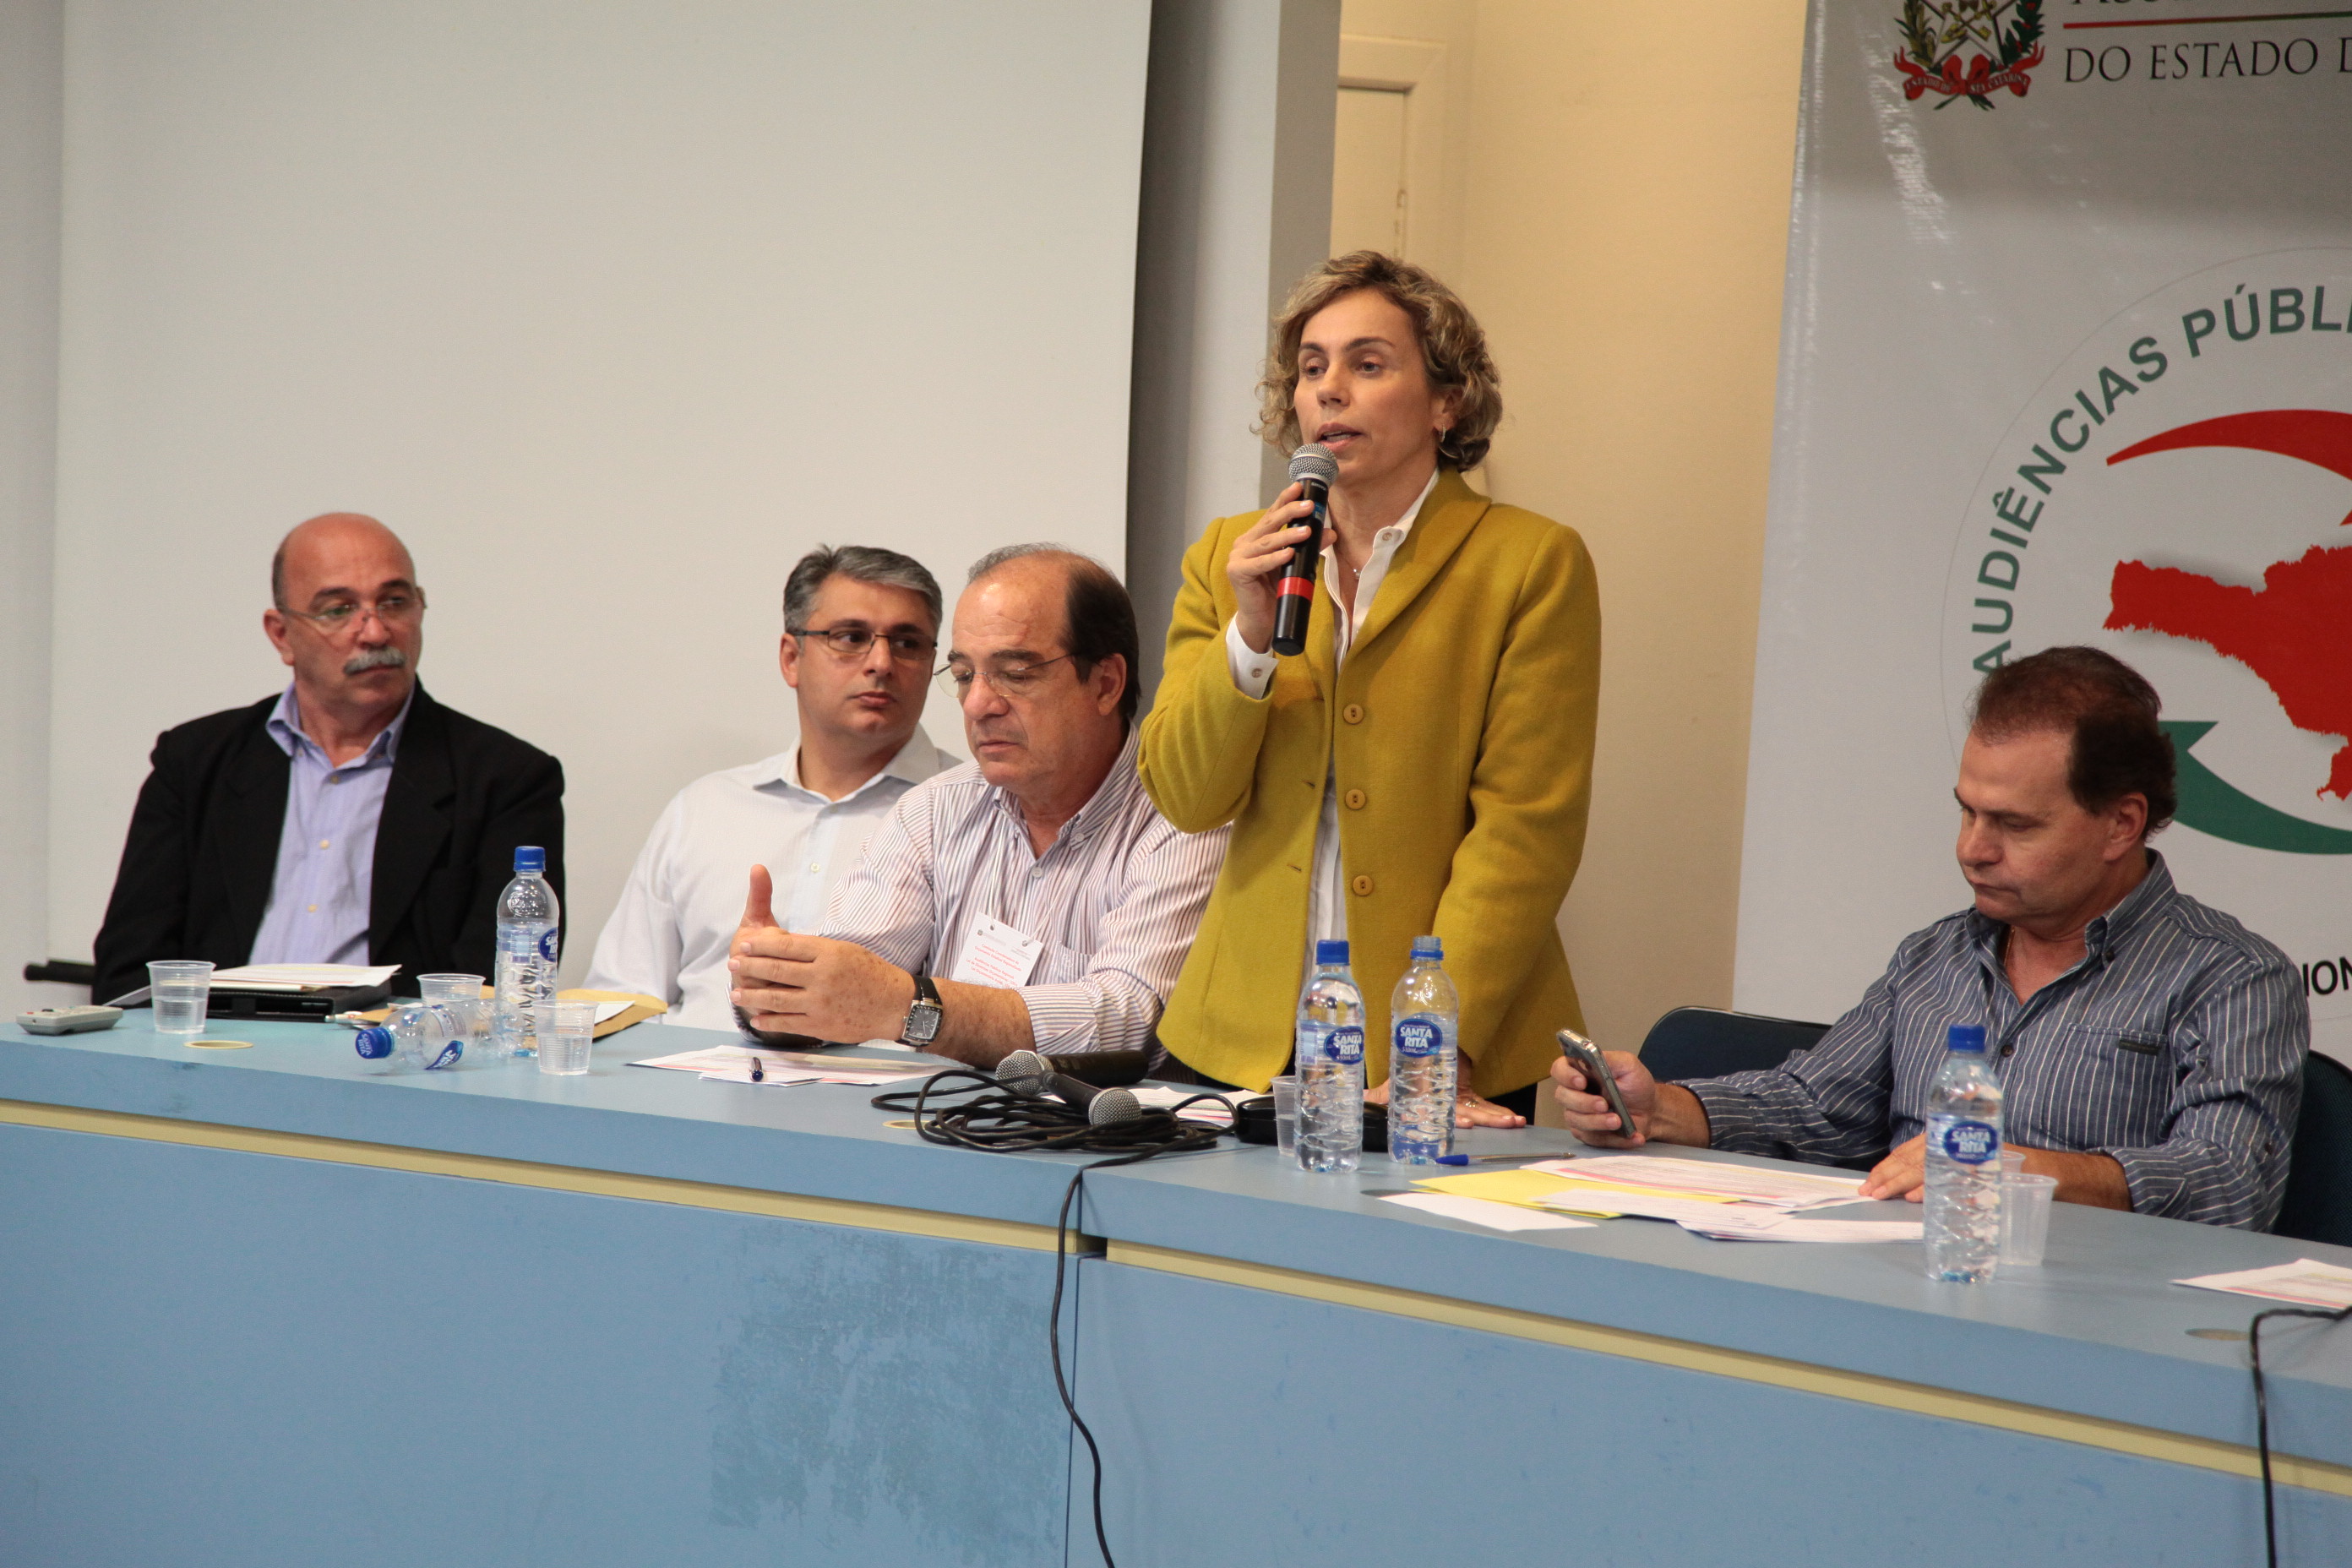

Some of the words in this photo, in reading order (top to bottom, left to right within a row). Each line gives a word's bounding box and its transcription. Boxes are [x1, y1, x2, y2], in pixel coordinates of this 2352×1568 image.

[2065, 46, 2132, 83] DO
[2150, 37, 2318, 80] ESTADO
[1971, 335, 2169, 674] AUDIÊNCIAS
[1400, 1026, 1433, 1038] SANTA
[361, 1032, 373, 1056] SANTA
[1333, 1035, 1362, 1047] SANTA
[1404, 1037, 1428, 1048] RITA
[1340, 1044, 1359, 1054] RITA
[1952, 1130, 1990, 1142] SANTA
[1958, 1141, 1987, 1153] RITA
